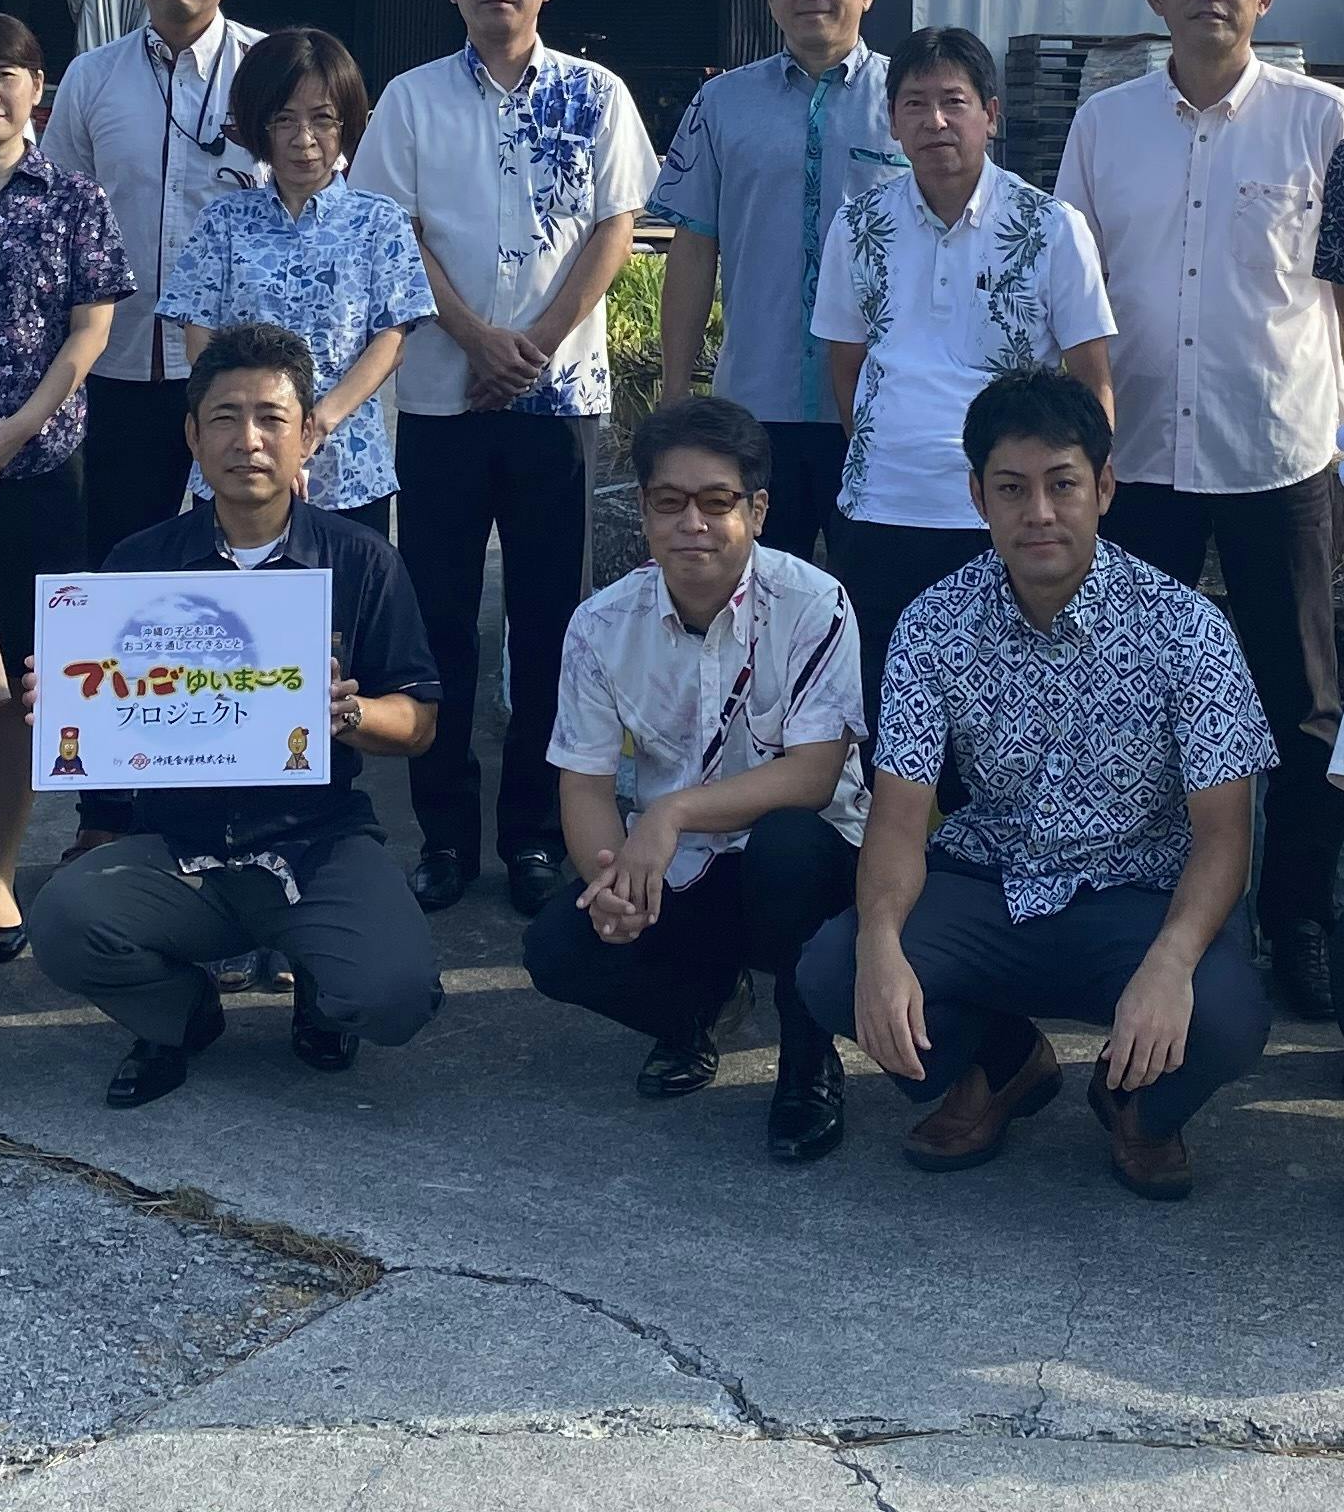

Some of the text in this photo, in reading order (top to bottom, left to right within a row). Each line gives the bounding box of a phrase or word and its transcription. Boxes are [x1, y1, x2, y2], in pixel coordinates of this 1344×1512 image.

[116, 702, 248, 726] プロジェクト
